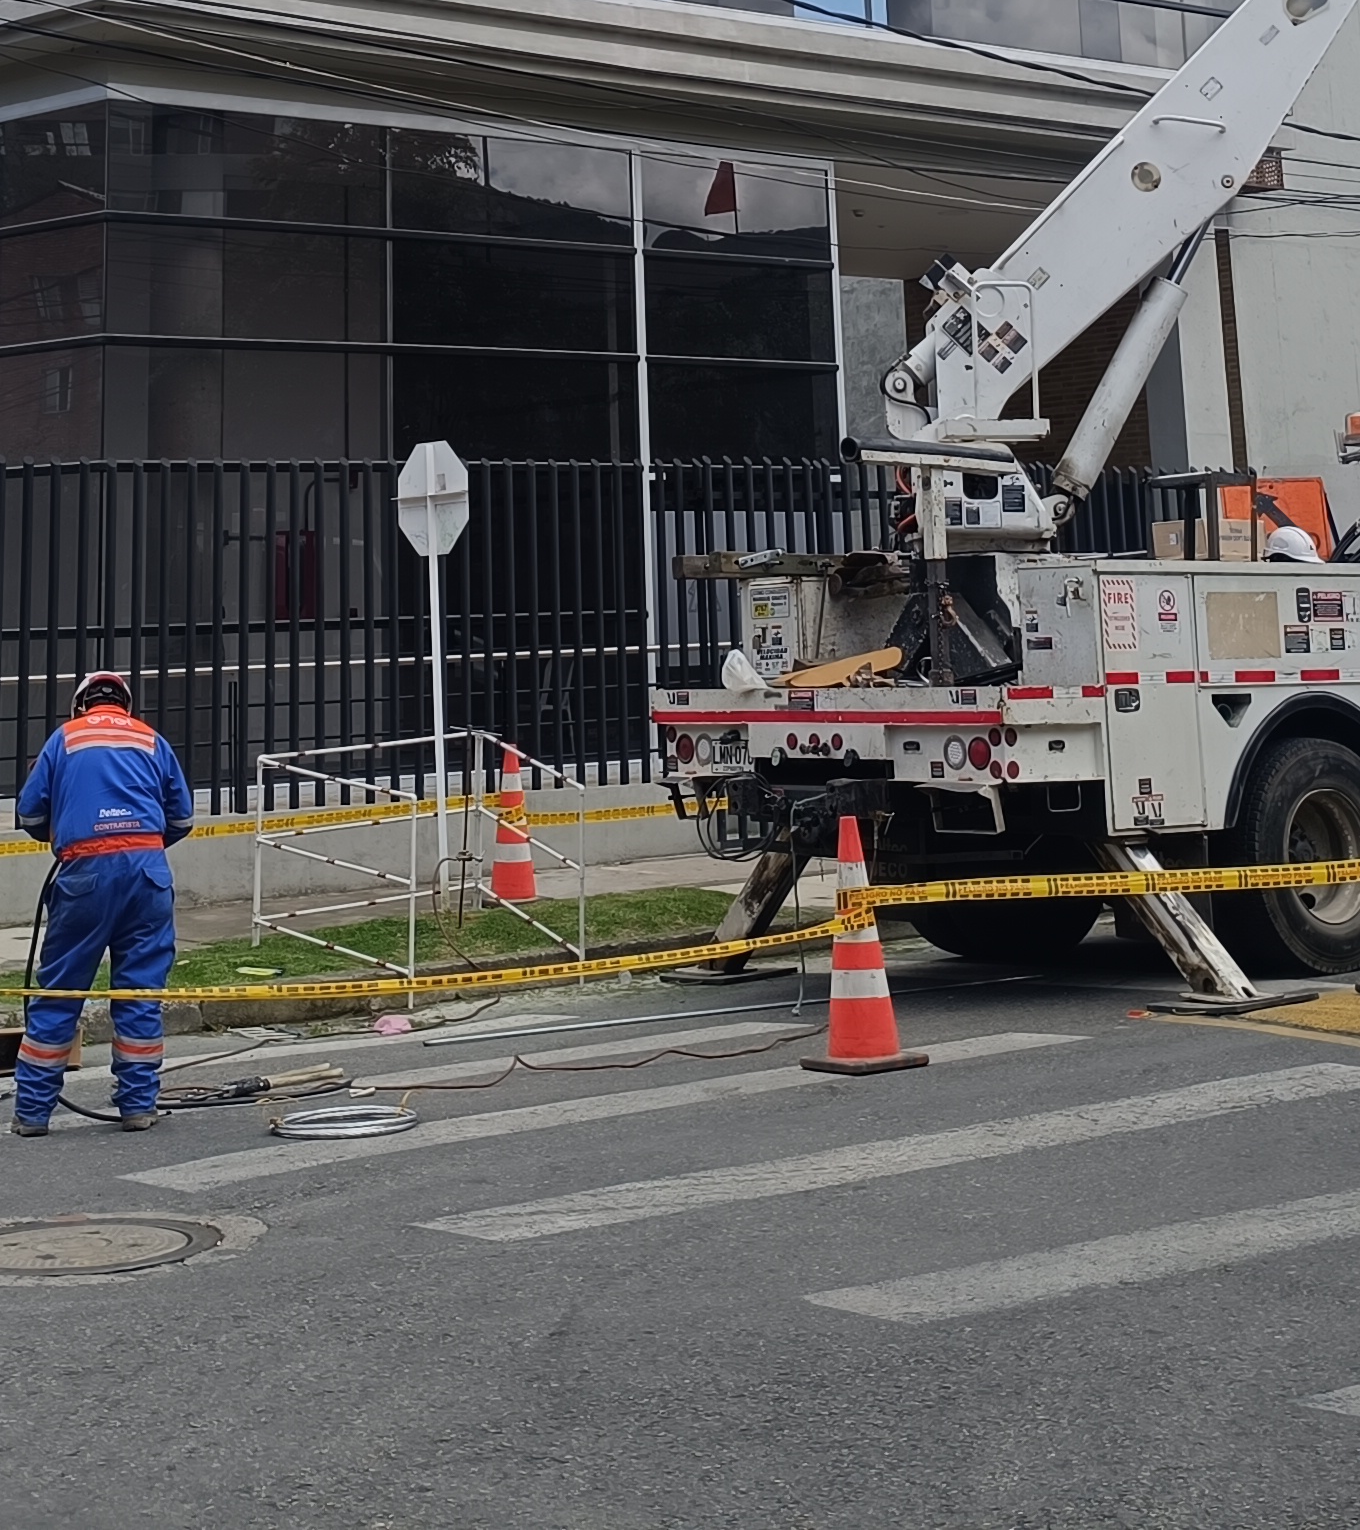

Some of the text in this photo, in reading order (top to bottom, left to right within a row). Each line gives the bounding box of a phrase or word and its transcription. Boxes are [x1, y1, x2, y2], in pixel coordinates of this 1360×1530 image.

[1107, 592, 1129, 604] FIRE
[86, 714, 133, 727] enel
[713, 745, 733, 765] LMN
[94, 820, 141, 832] CONTRATISTA
[849, 888, 926, 901] PELIGRO NO PASE
